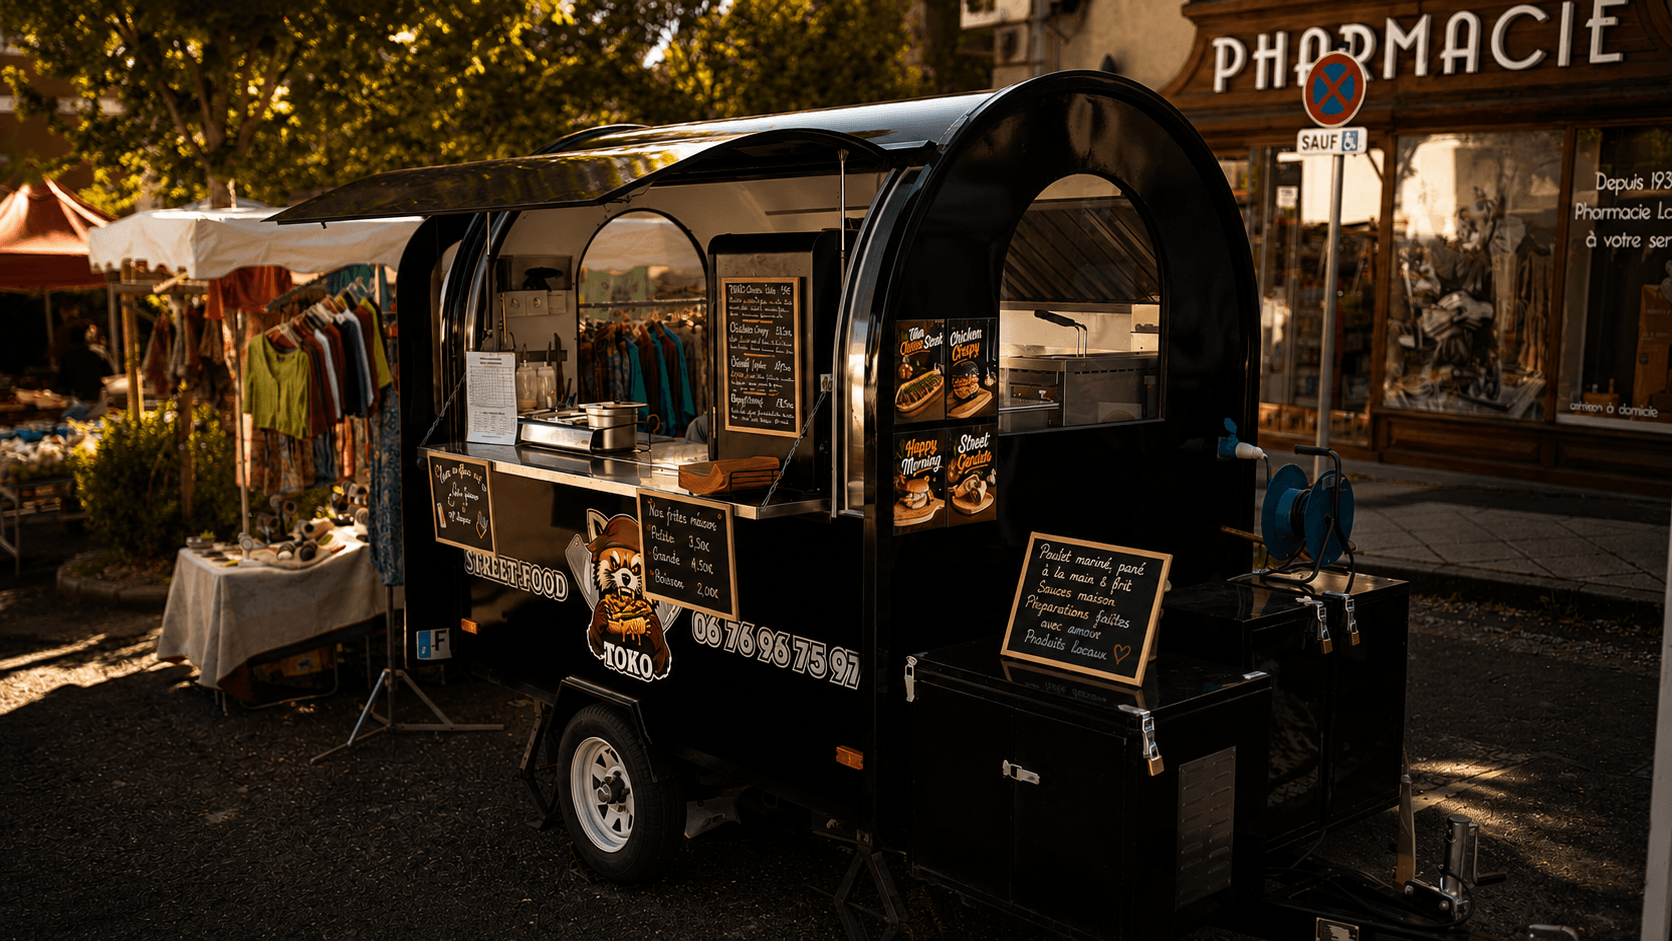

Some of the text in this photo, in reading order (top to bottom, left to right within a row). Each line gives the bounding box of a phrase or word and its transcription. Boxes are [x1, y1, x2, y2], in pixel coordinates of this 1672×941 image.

[1212, 0, 1628, 93] PHARMACIE
[1302, 134, 1338, 150] SAUF
[1595, 171, 1644, 196] Depuis
[1585, 230, 1597, 248] à
[1603, 232, 1641, 249] votre
[905, 439, 938, 458] Happy
[958, 432, 991, 453] Street
[901, 455, 942, 475] Morning
[1054, 566, 1065, 580] la
[1116, 562, 1147, 577] pané
[1037, 580, 1116, 607] Sauces maison
[1040, 620, 1063, 632] avec
[603, 640, 653, 680] TOKO
[692, 611, 861, 690] 06 76 96 75 97
